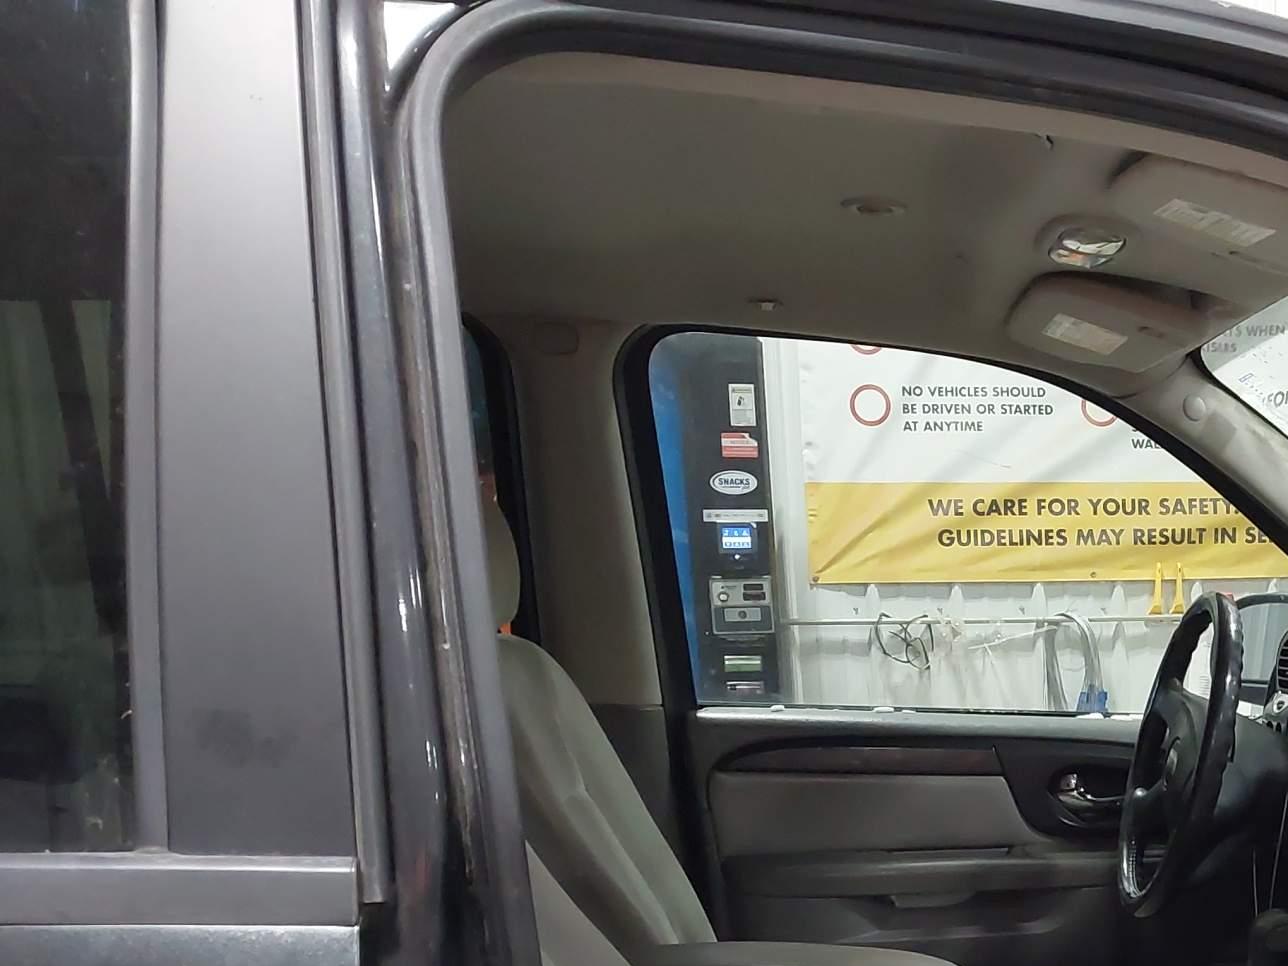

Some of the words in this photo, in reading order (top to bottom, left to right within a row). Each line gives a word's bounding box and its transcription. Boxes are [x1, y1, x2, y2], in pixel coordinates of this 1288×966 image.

[1246, 324, 1286, 336] WHEN
[902, 386, 923, 397] NO
[928, 386, 988, 397] VEHICLES
[992, 387, 1046, 398] SHOULD
[902, 403, 917, 414] BE
[922, 404, 971, 415] DRIVEN
[976, 404, 995, 415] OR
[1001, 404, 1054, 415] STARTED
[903, 421, 918, 431] AT
[923, 421, 983, 431] ANYTIME
[718, 478, 750, 486] SNACKS
[928, 499, 964, 516] WE
[972, 499, 1028, 516] CARE
[1036, 499, 1081, 516] FOR
[1088, 498, 1151, 516] YOUR
[937, 529, 1068, 547] GUIDELINES
[1076, 528, 1124, 546] MAY
[1133, 528, 1207, 546] RESULT
[1213, 528, 1237, 544] IN
[1245, 527, 1275, 544] SE
